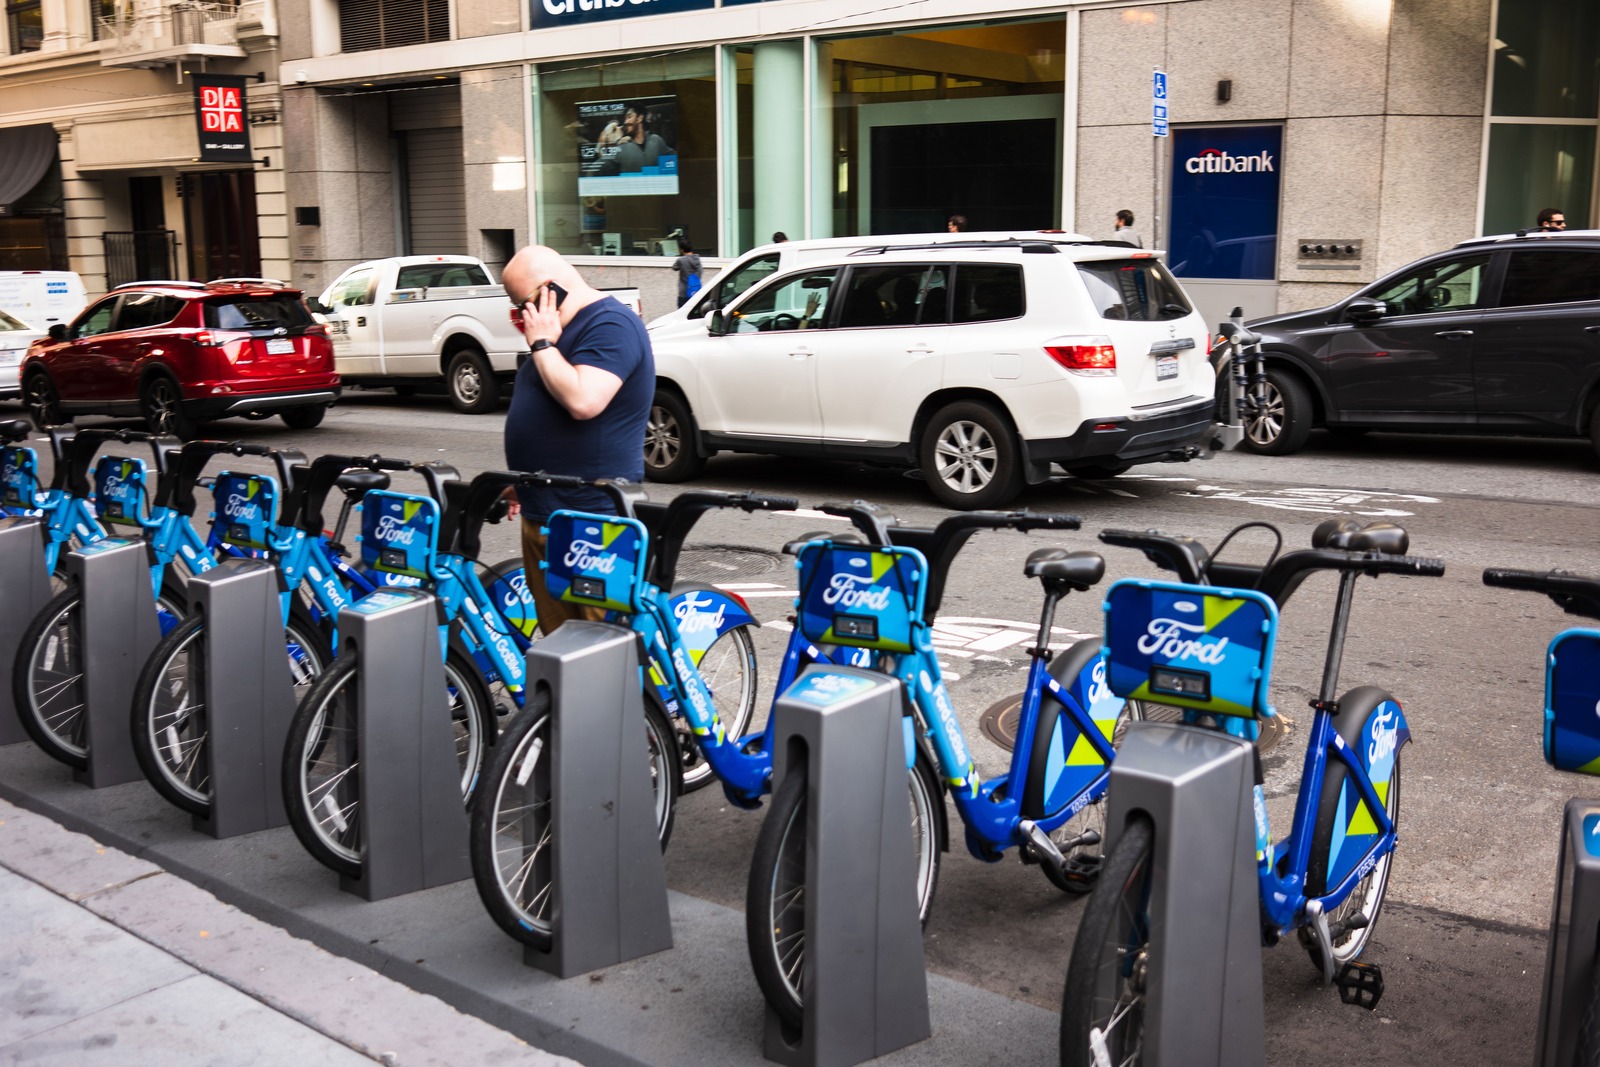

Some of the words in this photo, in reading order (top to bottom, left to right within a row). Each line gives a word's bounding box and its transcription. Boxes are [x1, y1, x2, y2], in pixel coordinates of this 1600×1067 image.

[1185, 149, 1274, 173] citibank
[103, 475, 129, 498] Ford
[224, 493, 257, 520] Ford
[374, 515, 416, 546] Ford
[563, 539, 618, 574] Ford
[323, 579, 345, 607] Ford
[823, 572, 891, 611] Ford
[674, 598, 726, 634] Ford
[495, 638, 522, 680] GoBike
[1137, 617, 1230, 666] Ford
[672, 647, 693, 683] Ford
[684, 677, 710, 723] GoBike
[933, 684, 952, 723] Ford
[945, 717, 967, 767] GoBike
[1368, 710, 1399, 765] Ford
